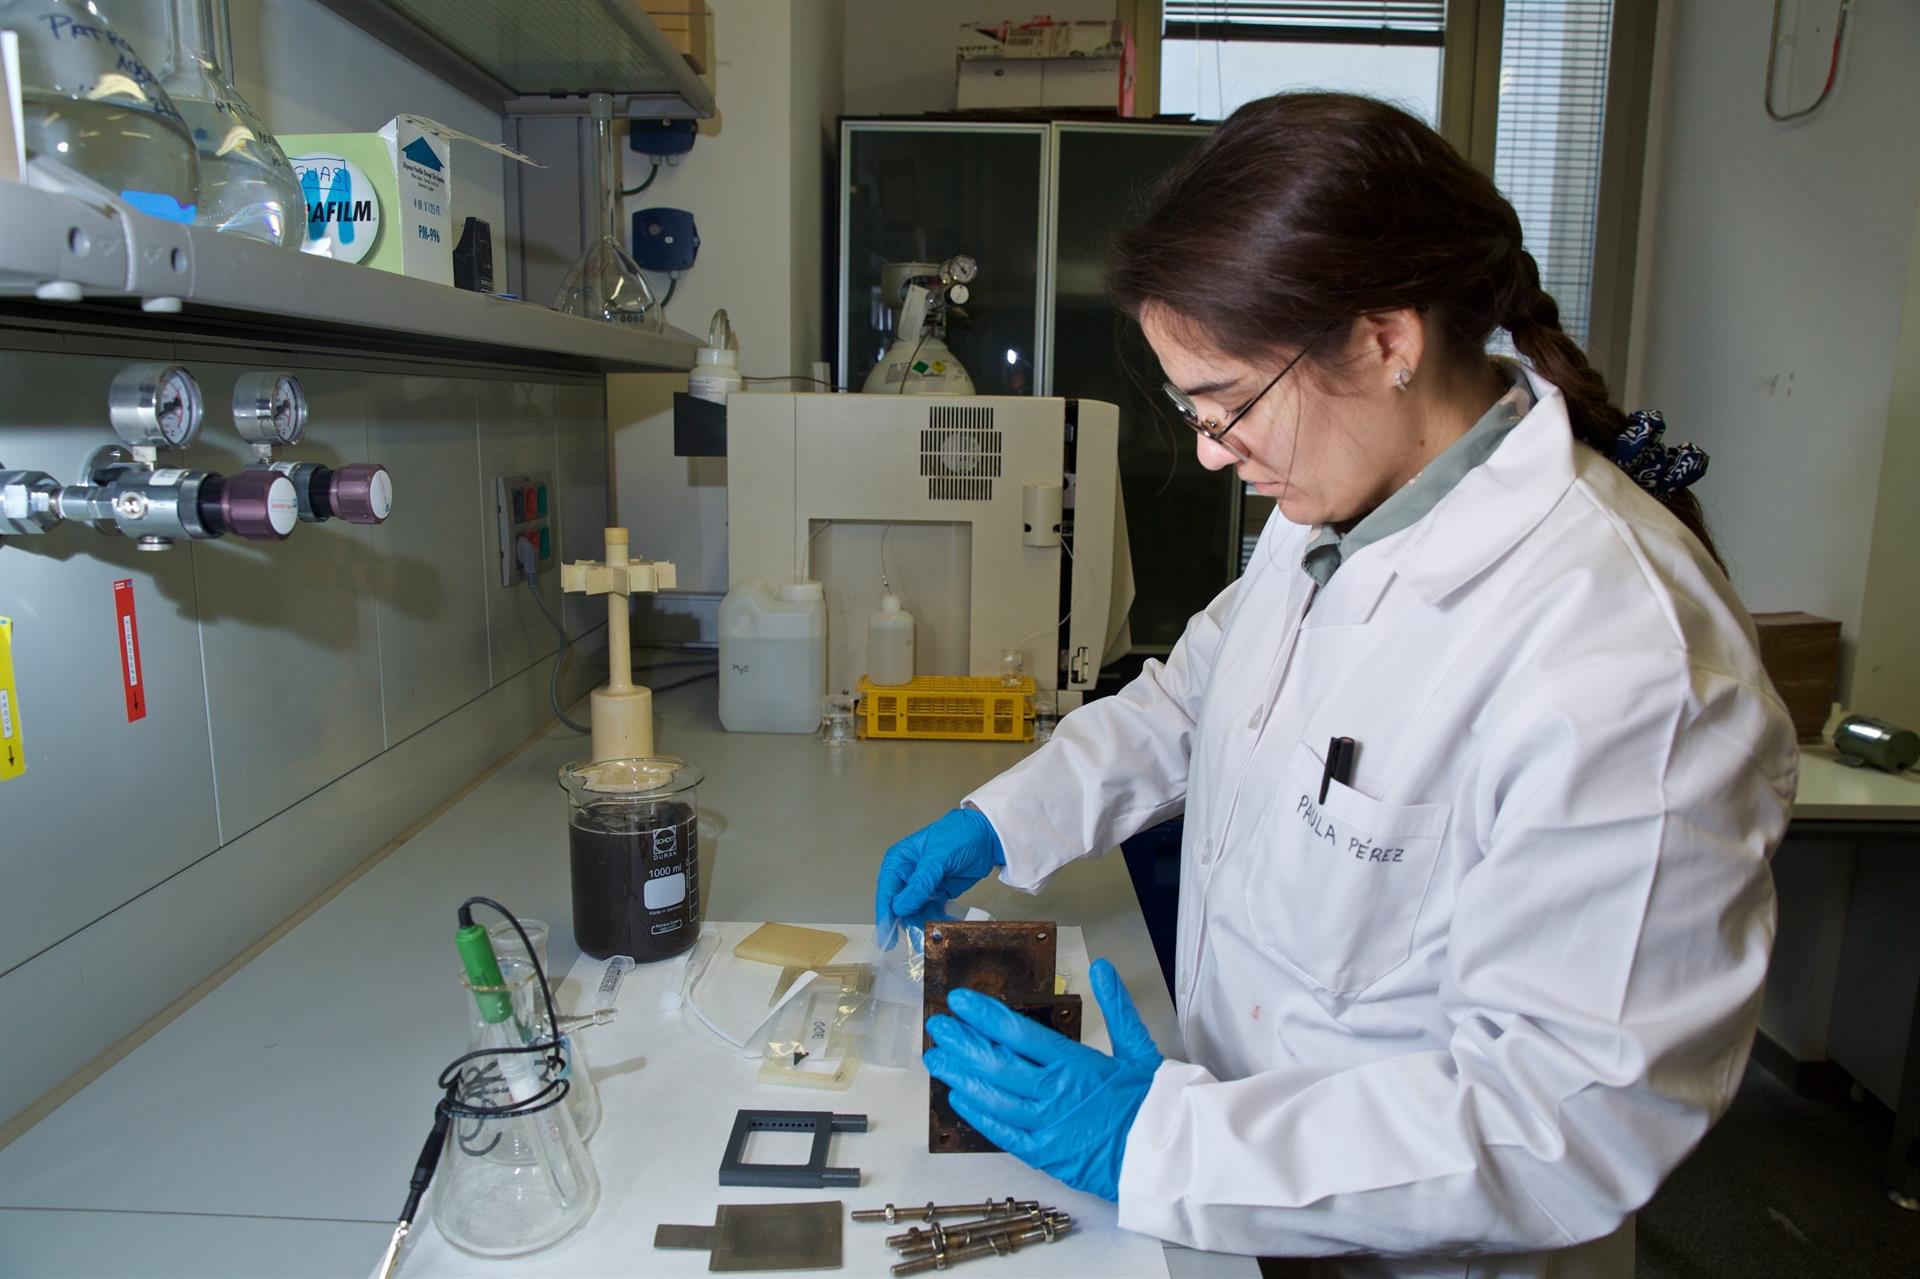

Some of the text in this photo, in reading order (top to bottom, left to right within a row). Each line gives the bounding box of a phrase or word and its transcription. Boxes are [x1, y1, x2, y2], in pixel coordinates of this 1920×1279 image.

[418, 224, 440, 243] PM-996
[1297, 795, 1335, 846] PAULA
[653, 851, 678, 861] DURAN
[648, 862, 683, 879] 1000 ml
